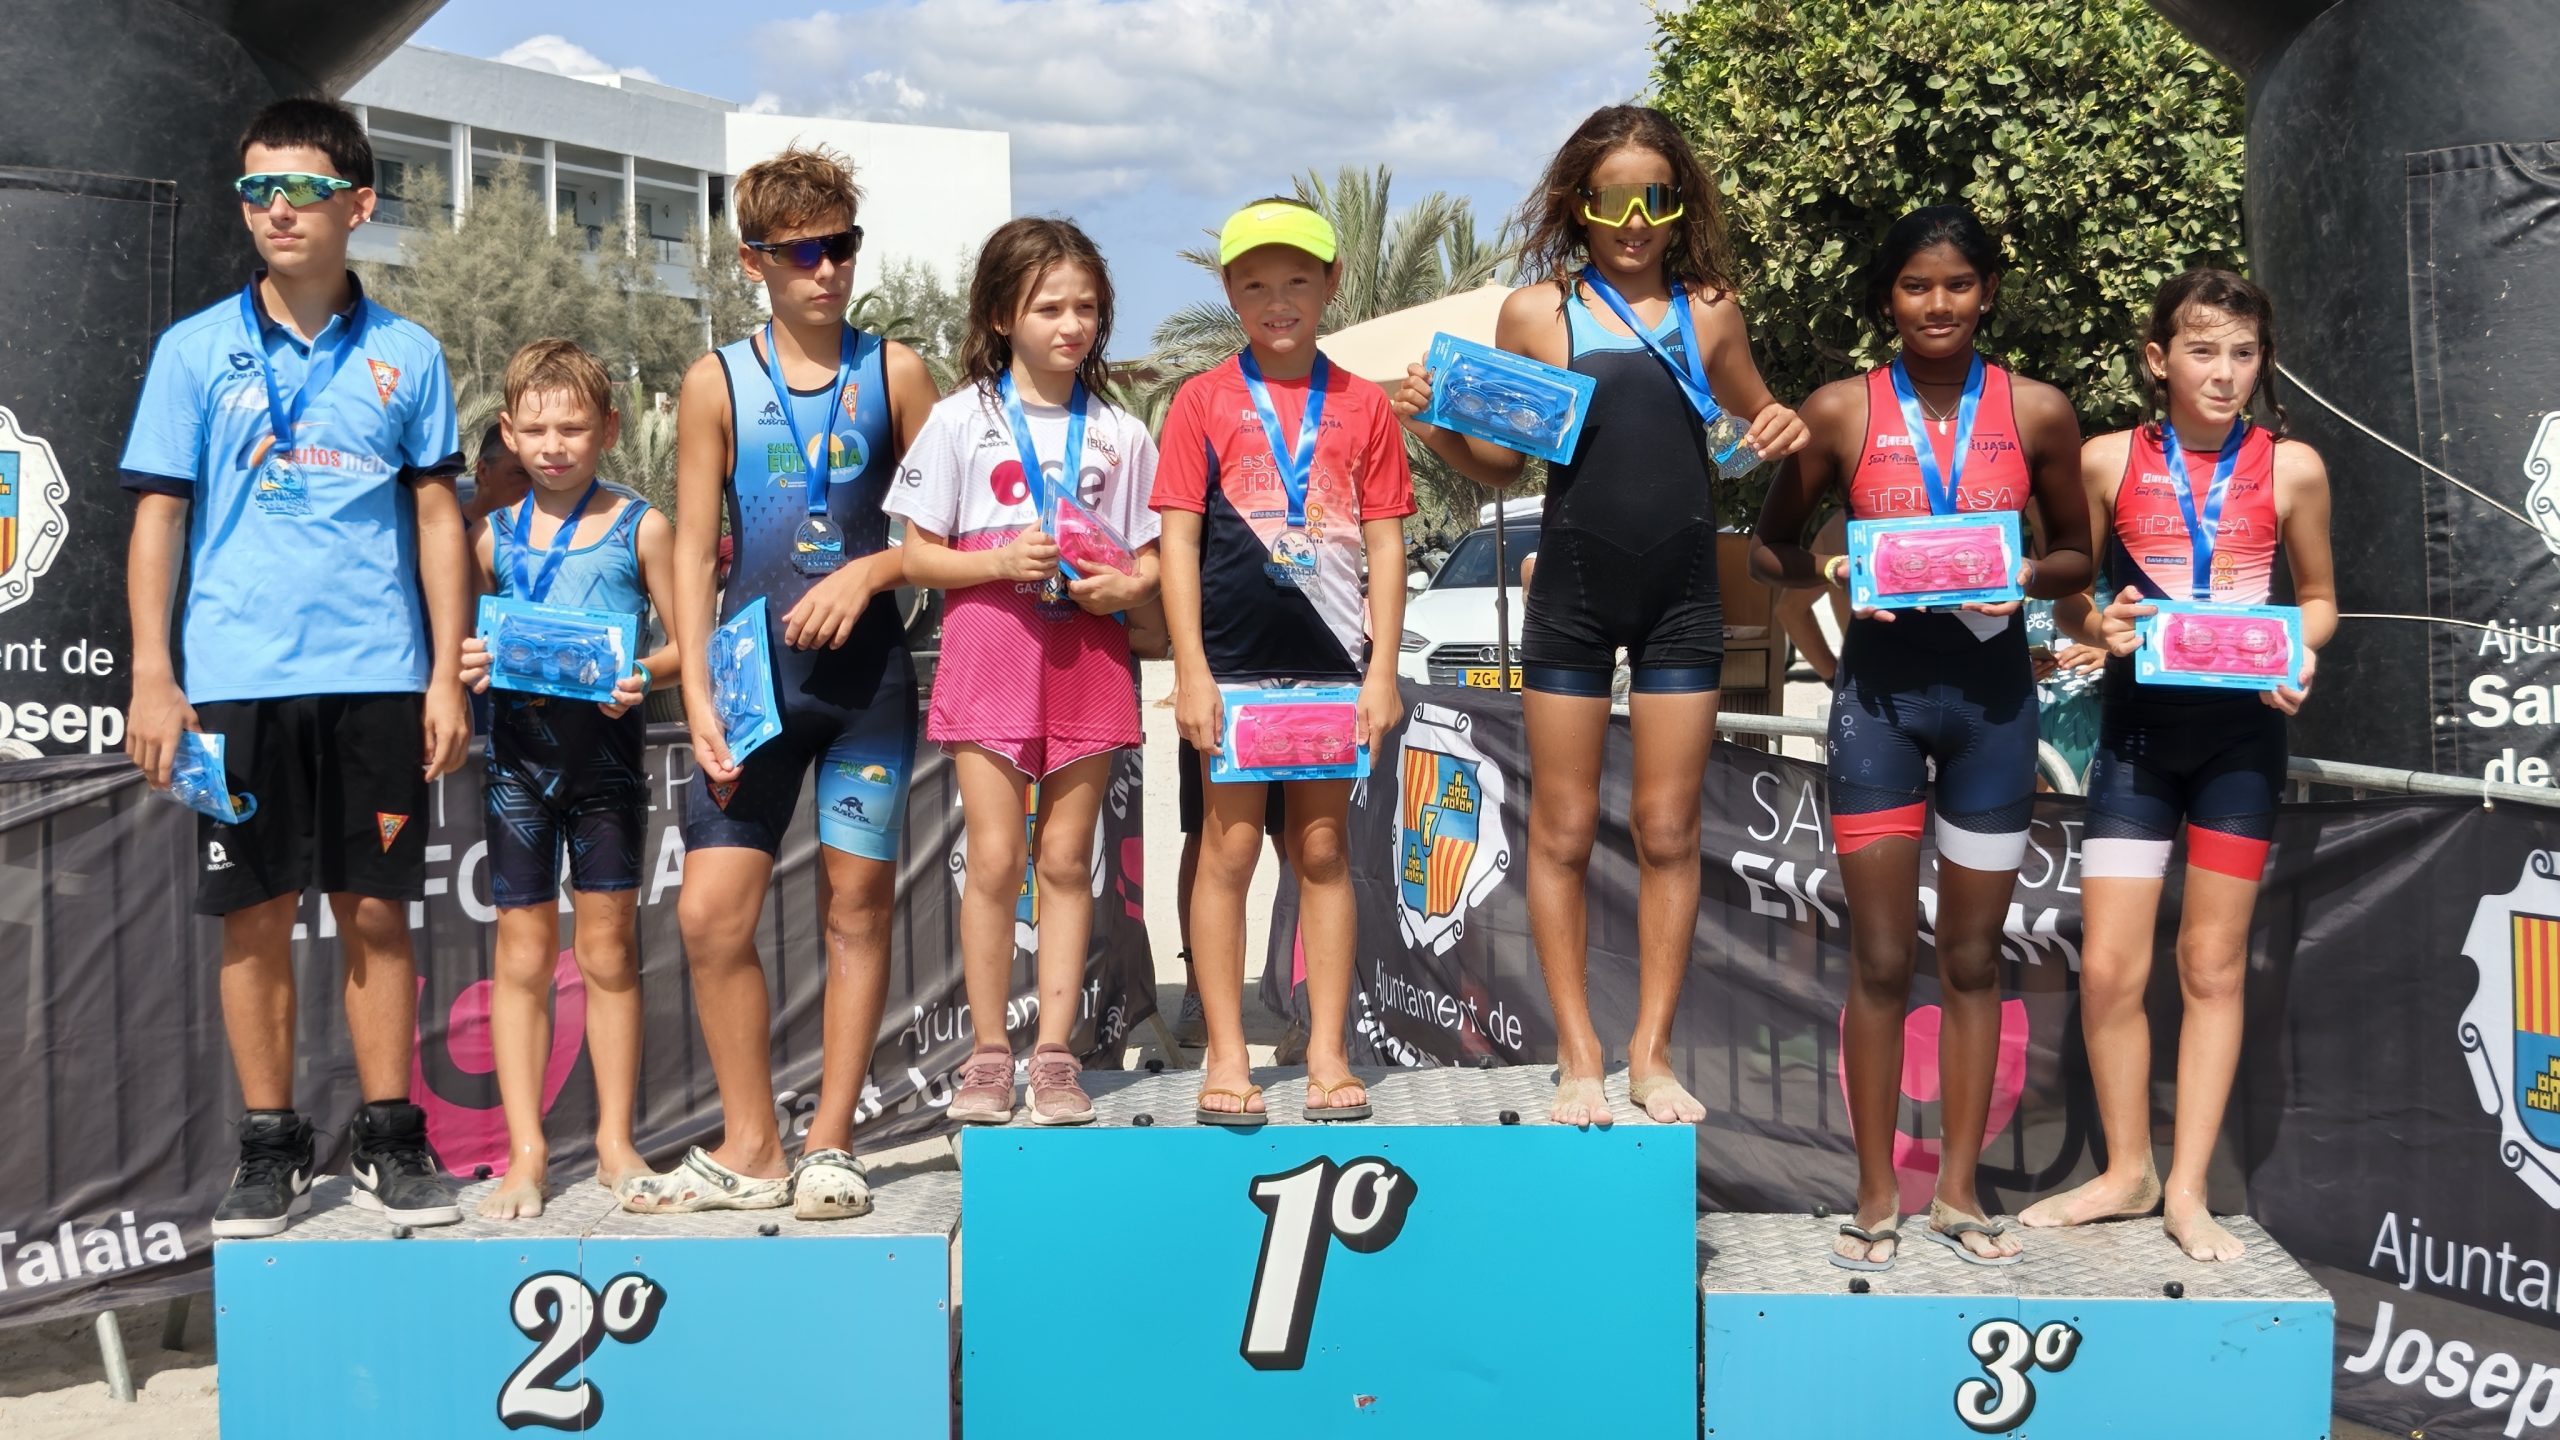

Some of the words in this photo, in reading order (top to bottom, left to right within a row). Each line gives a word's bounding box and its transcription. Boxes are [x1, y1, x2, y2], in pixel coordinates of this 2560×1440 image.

[767, 442, 800, 454] SANT
[1970, 438, 2017, 451] RIJASA
[768, 448, 863, 474] EULRIA
[898, 463, 923, 489] ne
[1867, 486, 2014, 513] TRIASA
[2136, 513, 2252, 538] TRISA
[0, 638, 47, 672] nt
[62, 638, 114, 676] de
[2467, 674, 2560, 728] Sa
[2484, 748, 2549, 788] de
[1375, 958, 1487, 1036] Ajuntament
[1488, 1001, 1523, 1050] de
[2368, 1211, 2560, 1314] Ajunta
[2343, 1300, 2560, 1438] Josep
